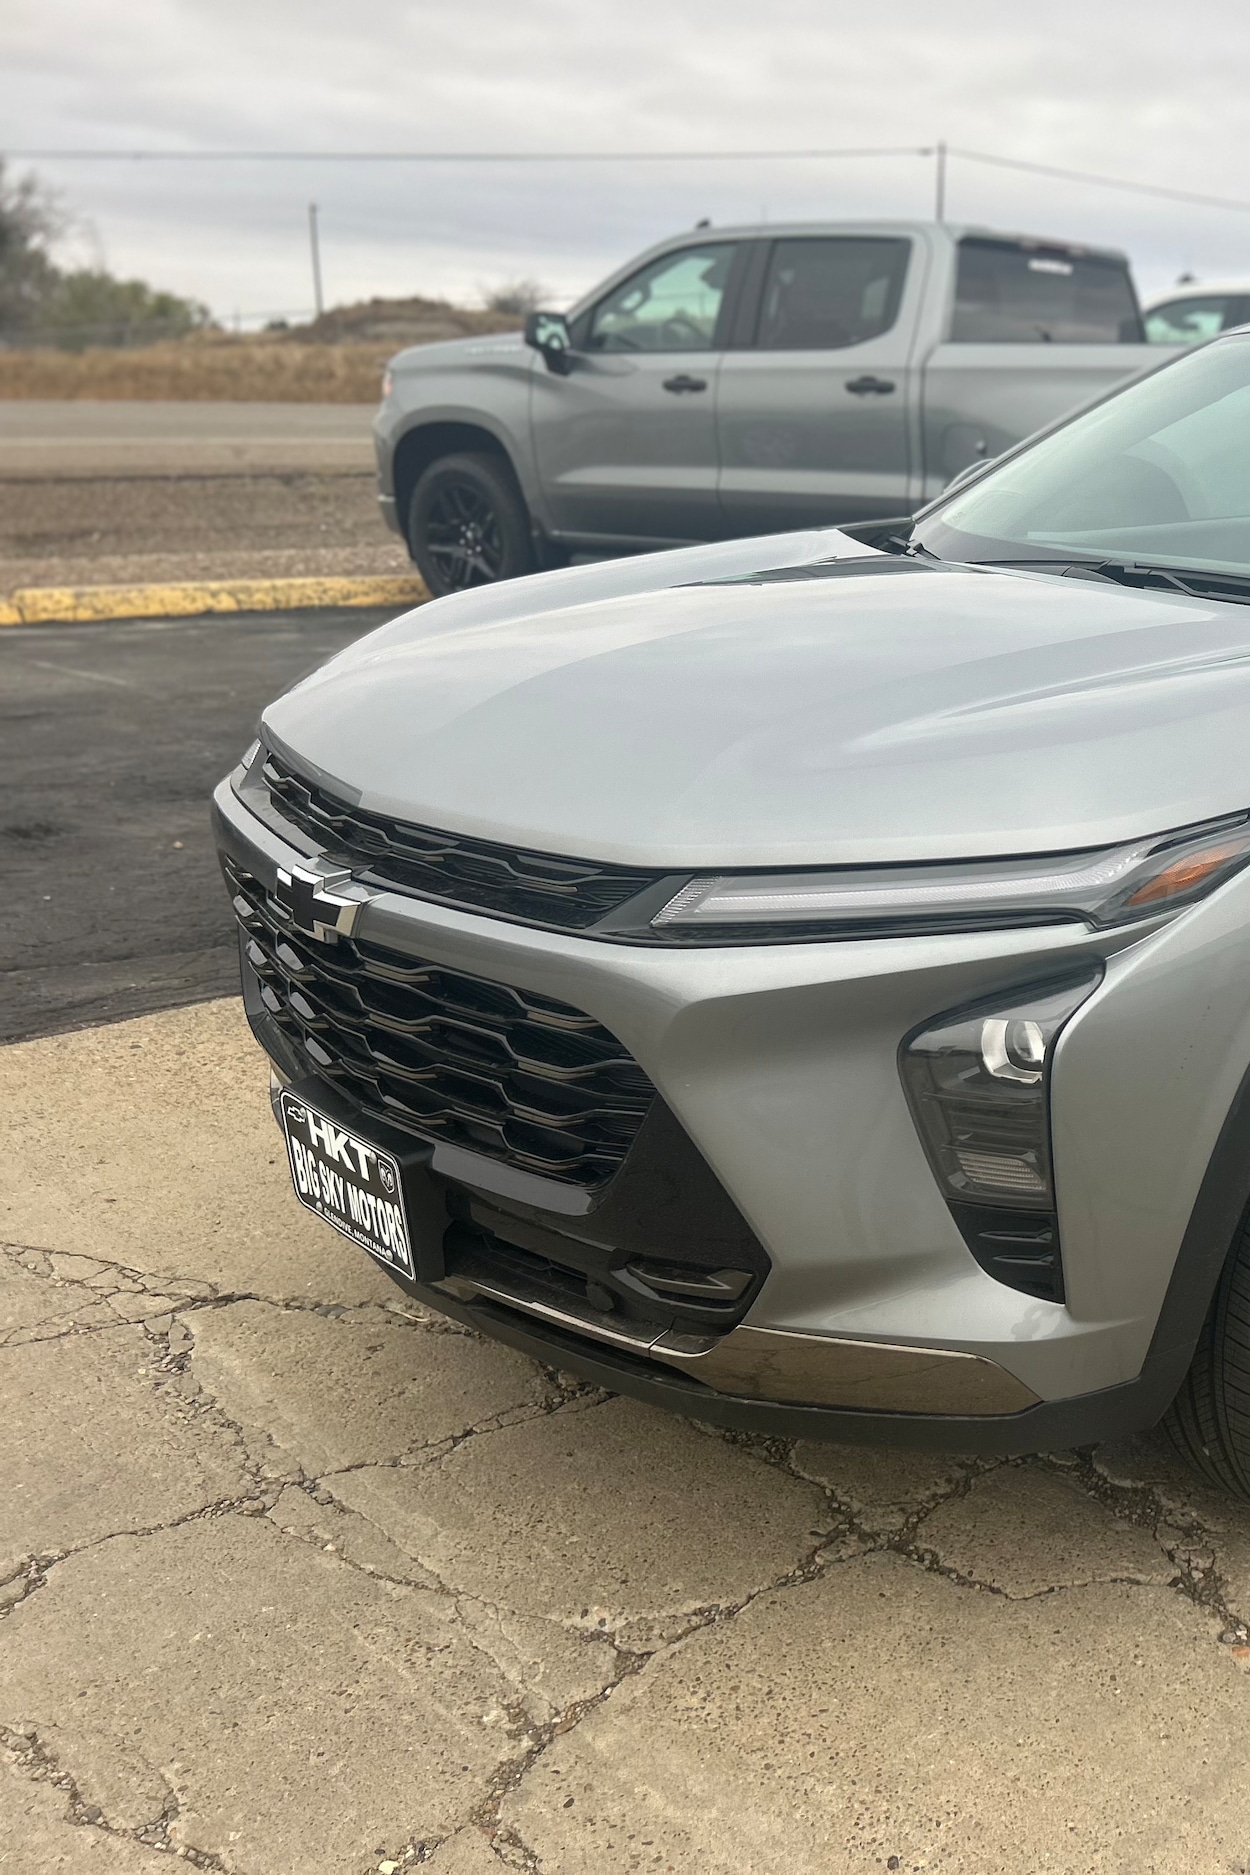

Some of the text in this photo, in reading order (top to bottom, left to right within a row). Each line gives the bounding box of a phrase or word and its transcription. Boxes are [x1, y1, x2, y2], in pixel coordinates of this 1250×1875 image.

[306, 1109, 373, 1181] HKT
[291, 1135, 409, 1265] BIG SKY MOTORS
[354, 1229, 386, 1256] MONTANA
